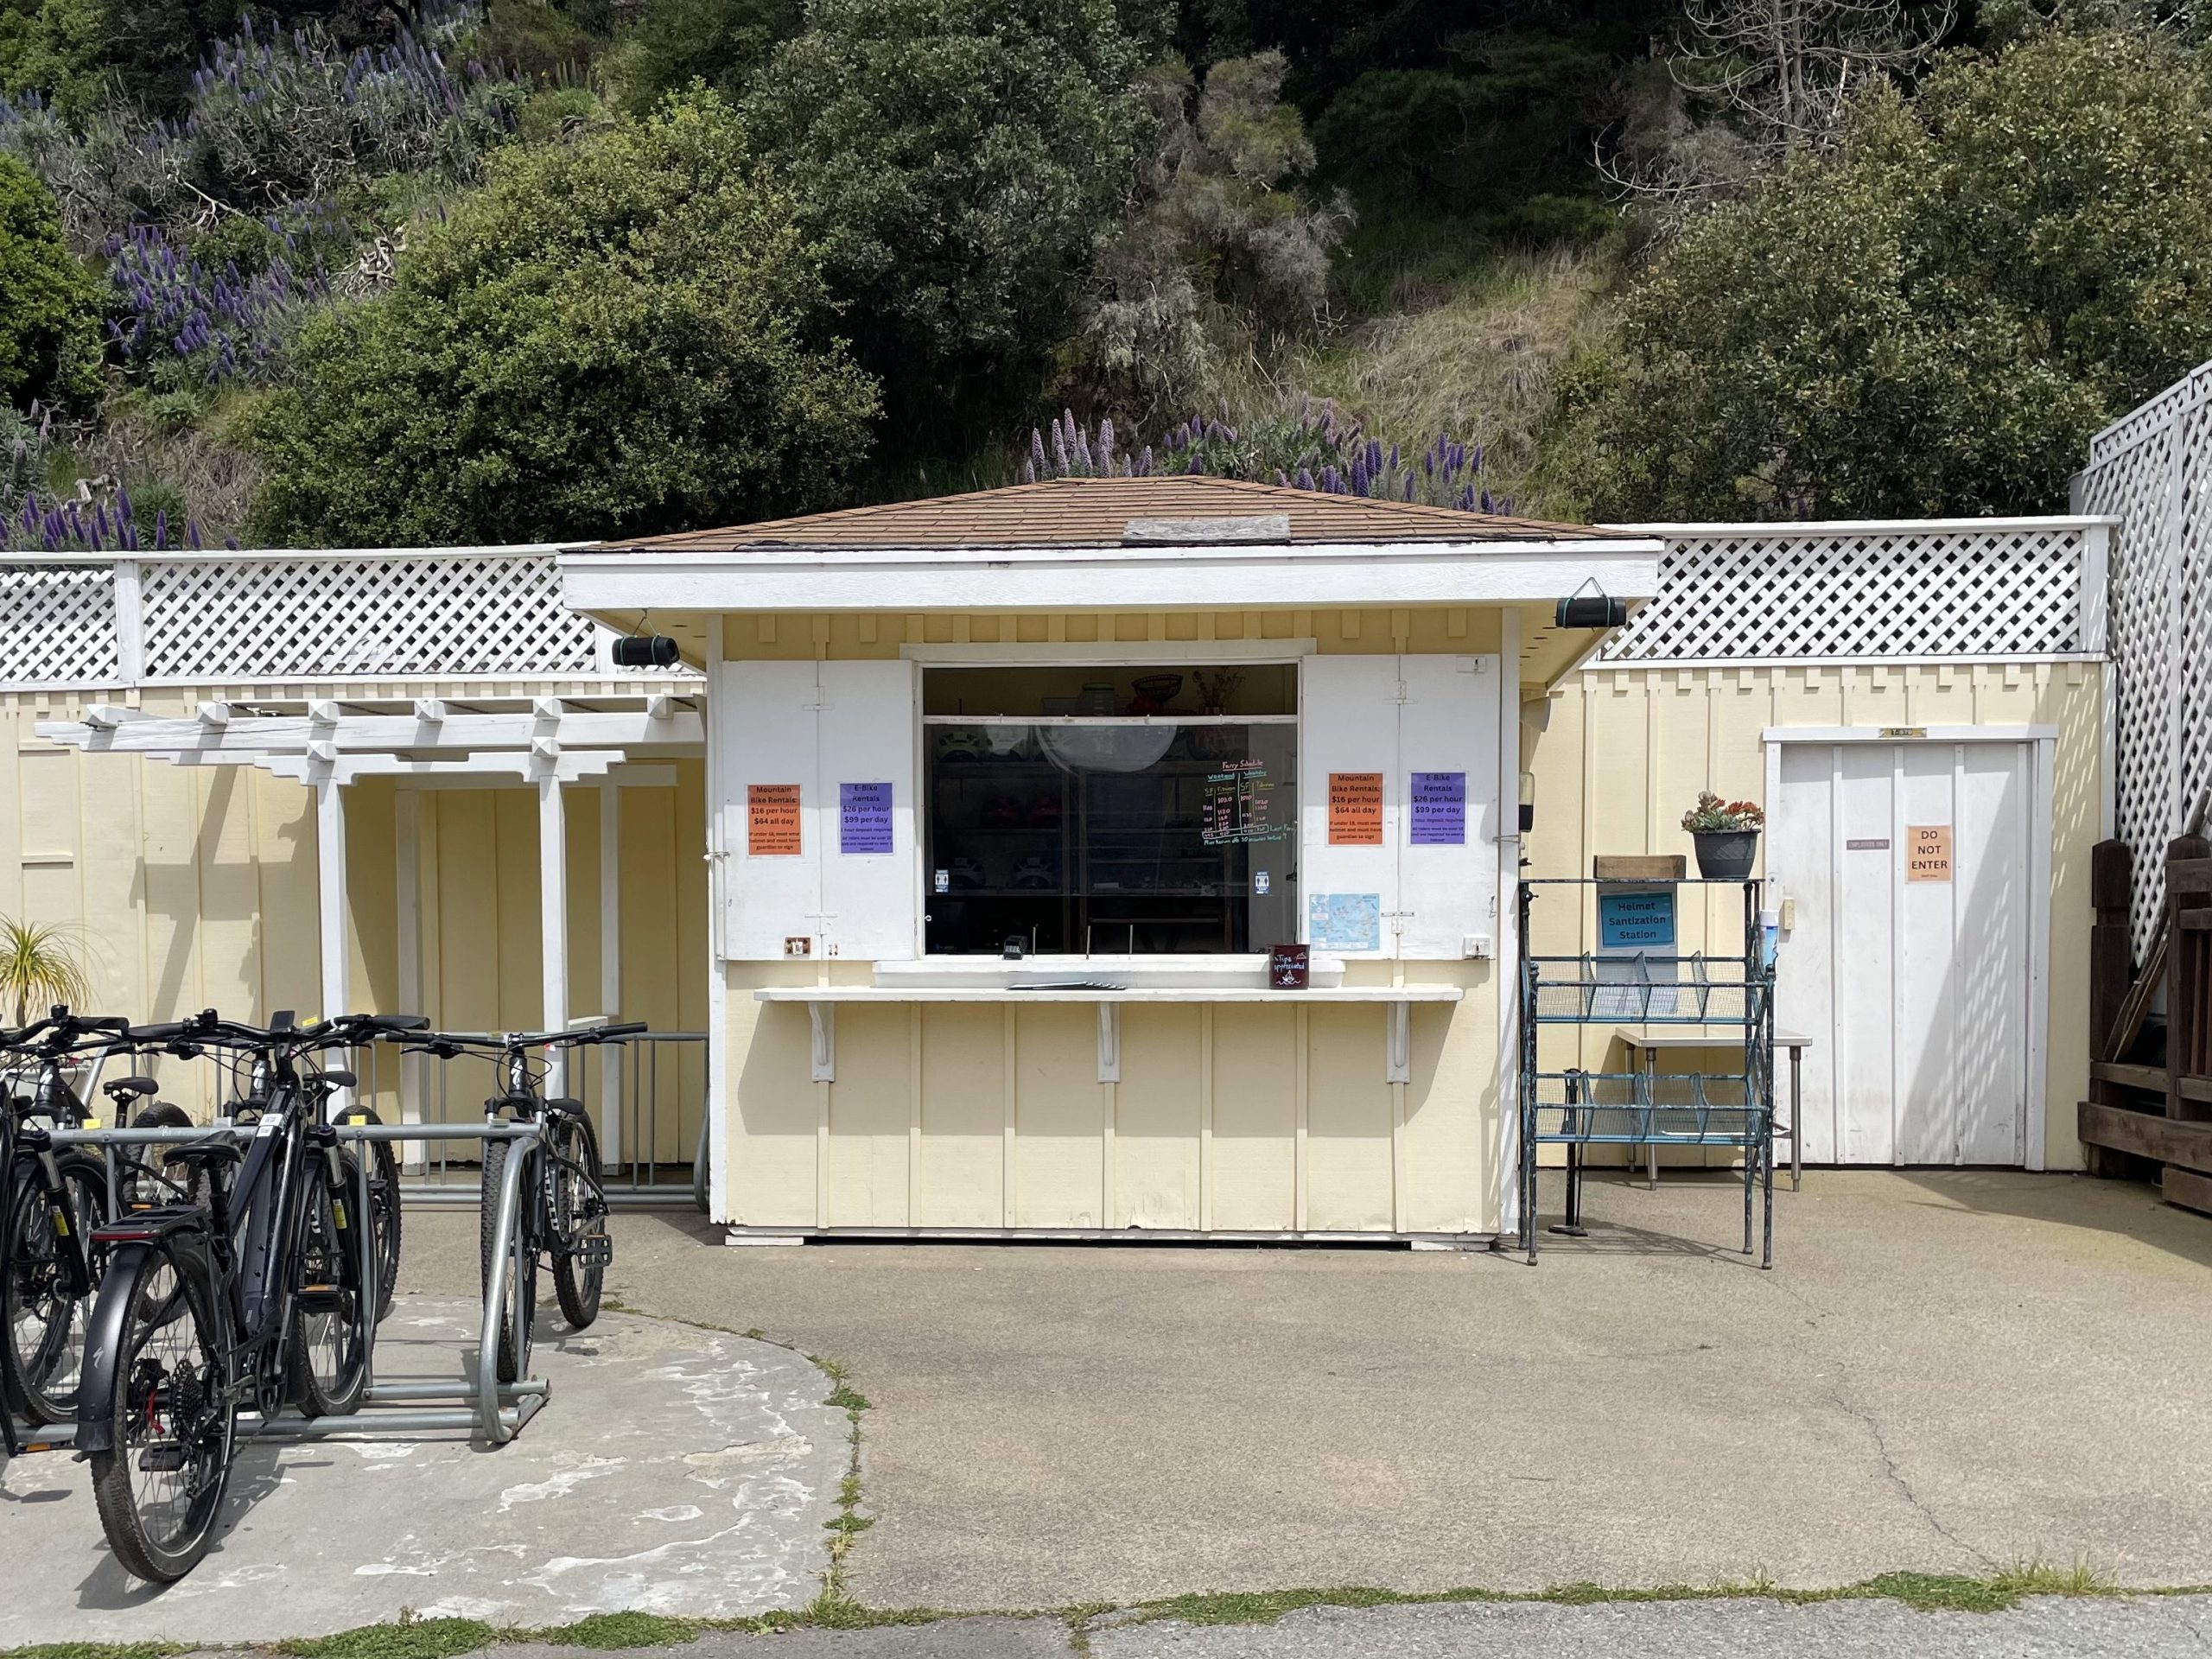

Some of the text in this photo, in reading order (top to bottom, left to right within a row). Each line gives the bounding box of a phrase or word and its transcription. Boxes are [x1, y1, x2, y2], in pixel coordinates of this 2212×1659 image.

[1241, 782, 1249, 791] SF
[1362, 806, 1376, 815] day
[1446, 806, 1460, 815] day
[780, 817, 794, 826] day
[1921, 830, 1938, 840] DO
[1917, 845, 1942, 855] NOT
[1911, 861, 1948, 869] ENTER
[1618, 902, 1656, 912] Helmet
[1609, 916, 1666, 925] Santization
[1619, 930, 1656, 939] Station
[1277, 954, 1293, 964] Tips
